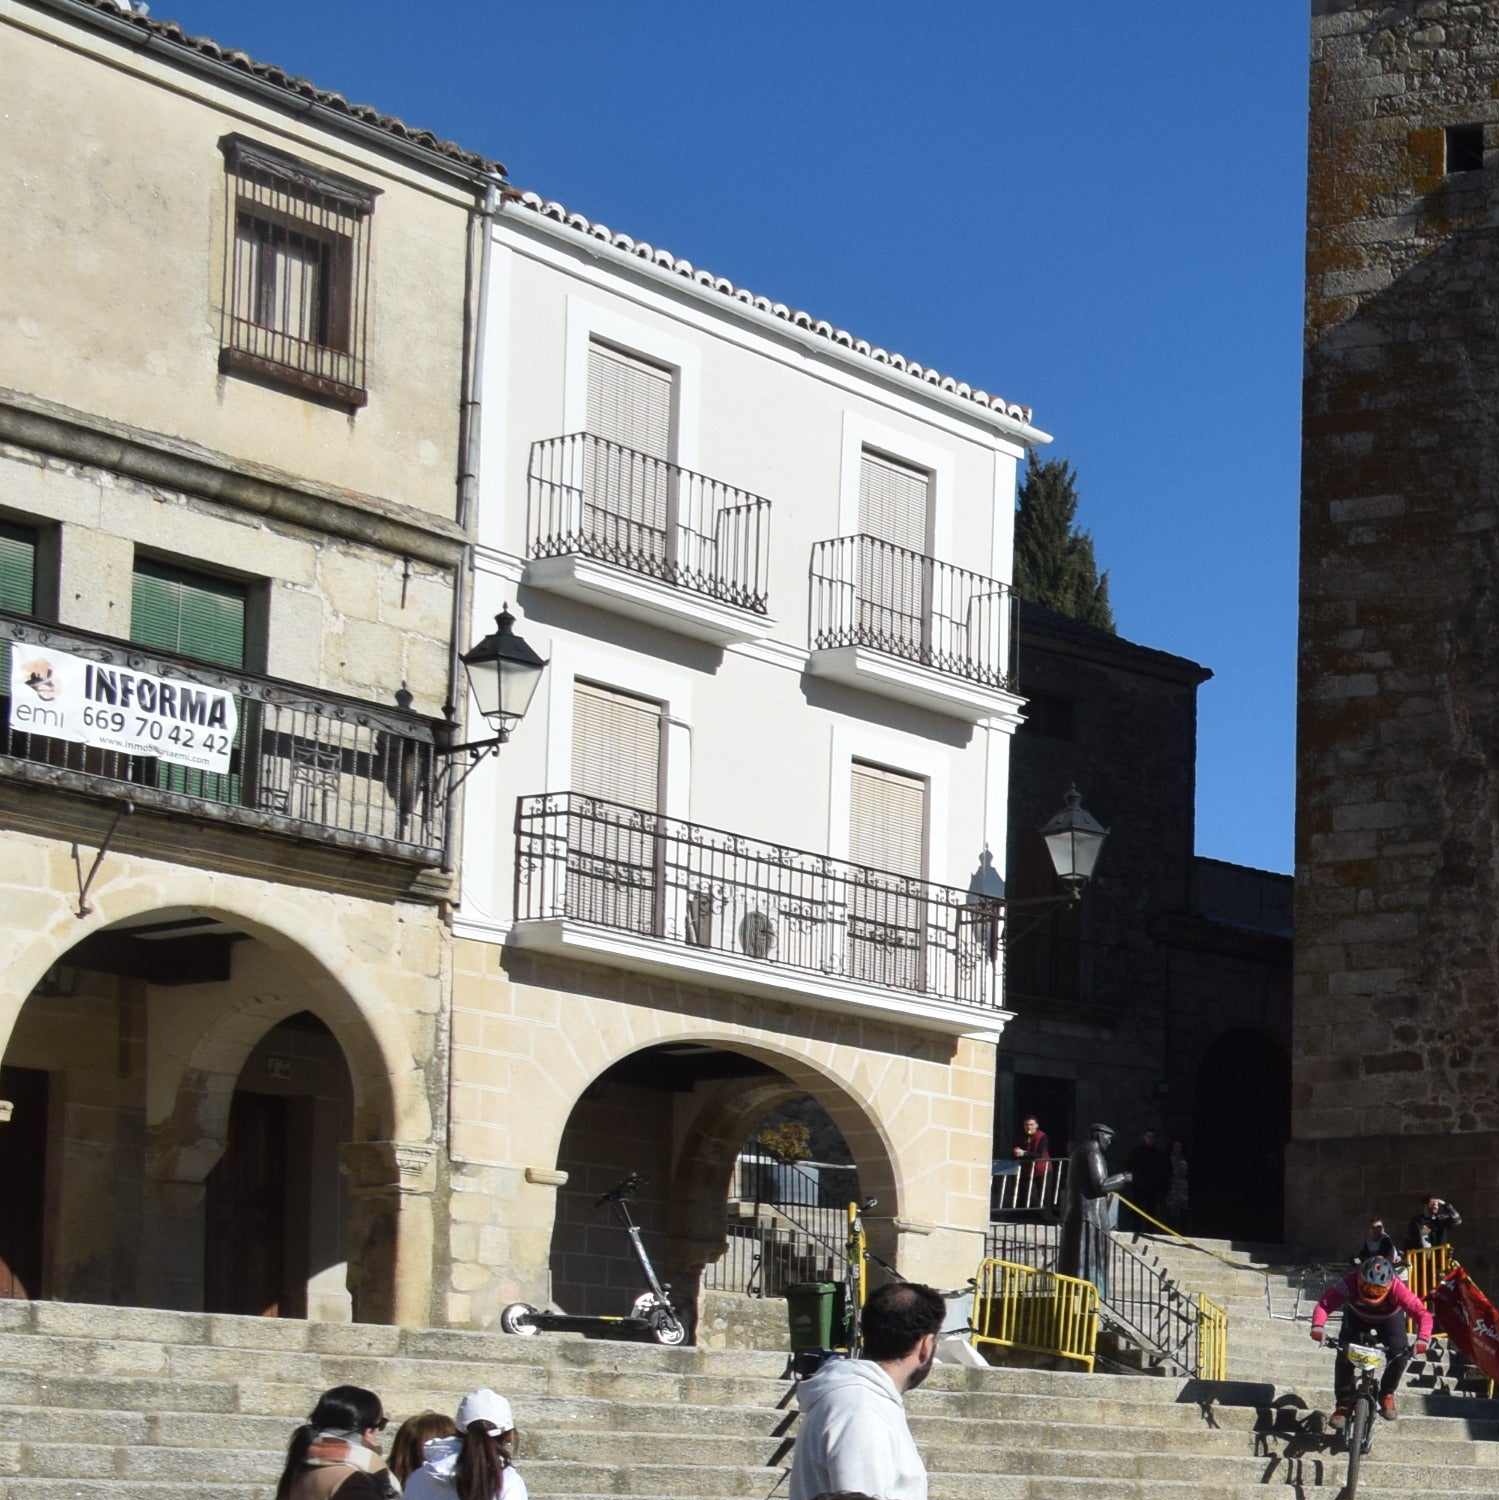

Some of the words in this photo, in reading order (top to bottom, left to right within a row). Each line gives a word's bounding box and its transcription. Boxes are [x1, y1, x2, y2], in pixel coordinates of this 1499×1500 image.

[16, 703, 65, 728] emi
[85, 664, 229, 731] INFORMA
[83, 706, 125, 732] 669
[136, 717, 163, 740] 70
[168, 726, 195, 749] 42
[202, 733, 230, 756] 42
